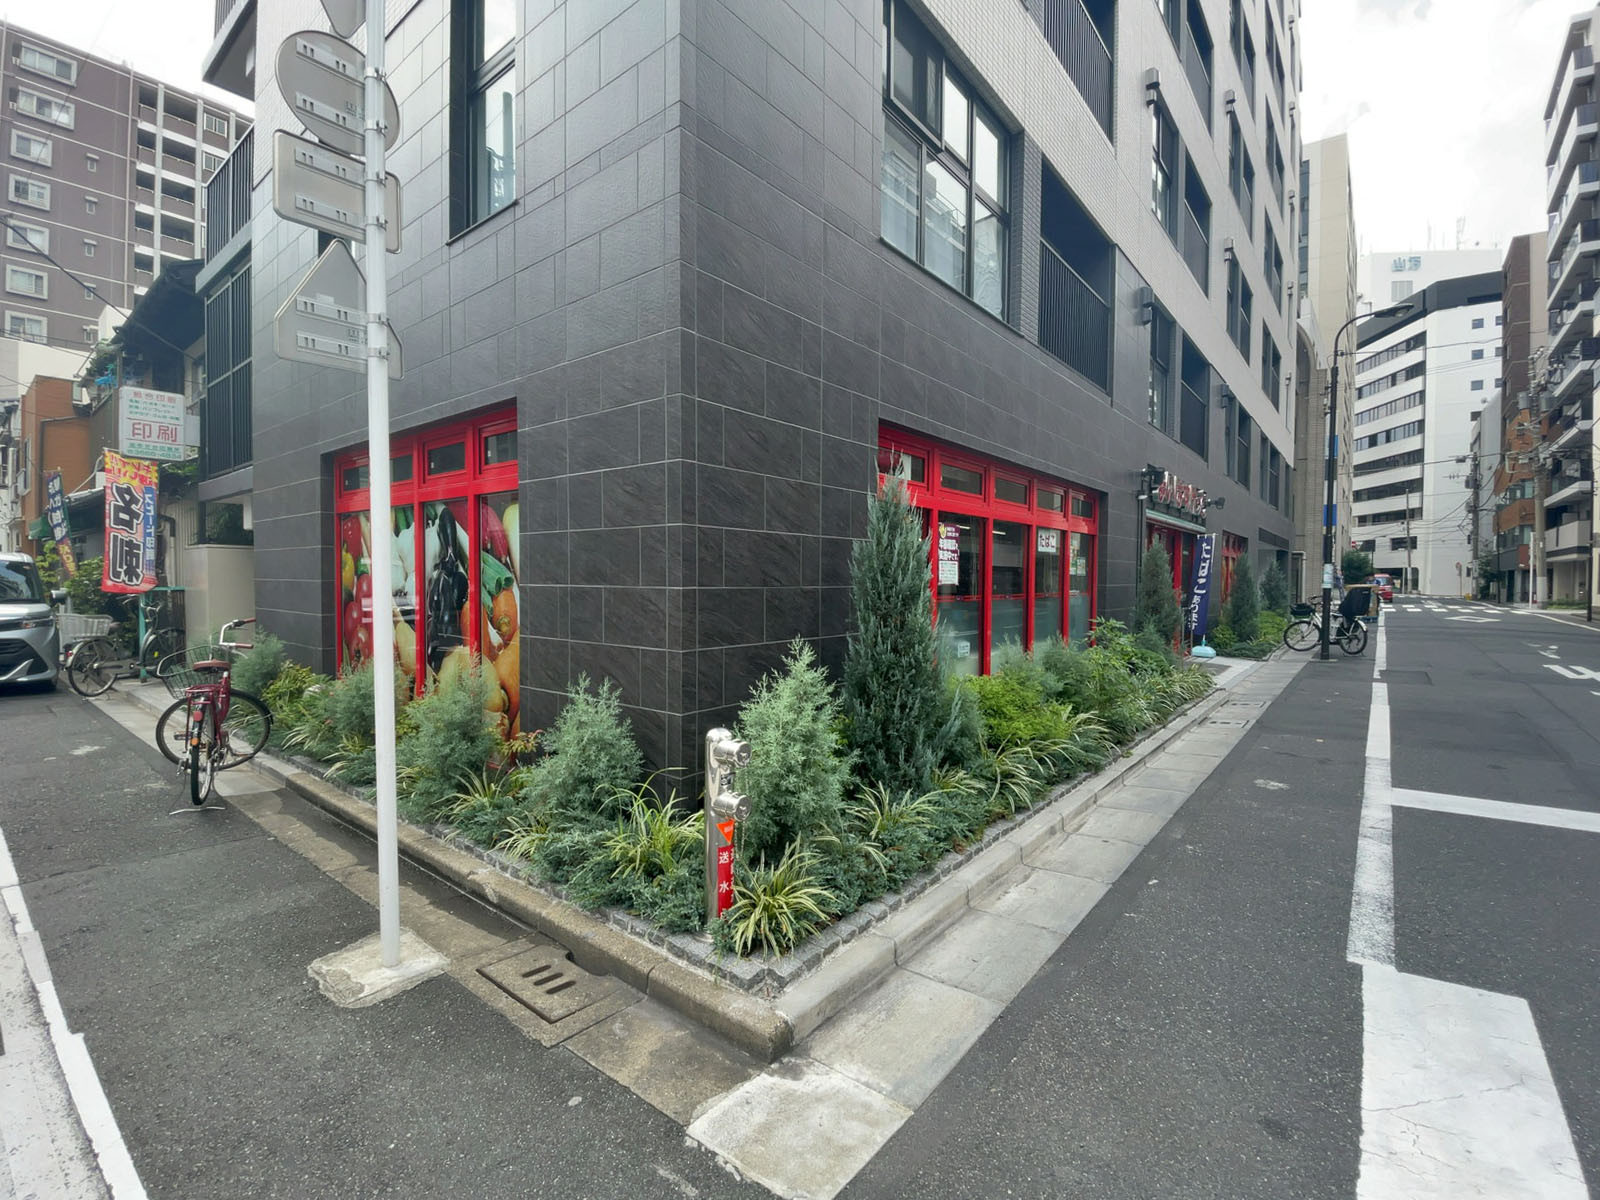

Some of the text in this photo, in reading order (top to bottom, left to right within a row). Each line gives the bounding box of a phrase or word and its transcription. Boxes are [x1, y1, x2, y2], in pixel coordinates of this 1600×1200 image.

[132, 421, 177, 443] 印刷
[1039, 533, 1055, 549] たばこ
